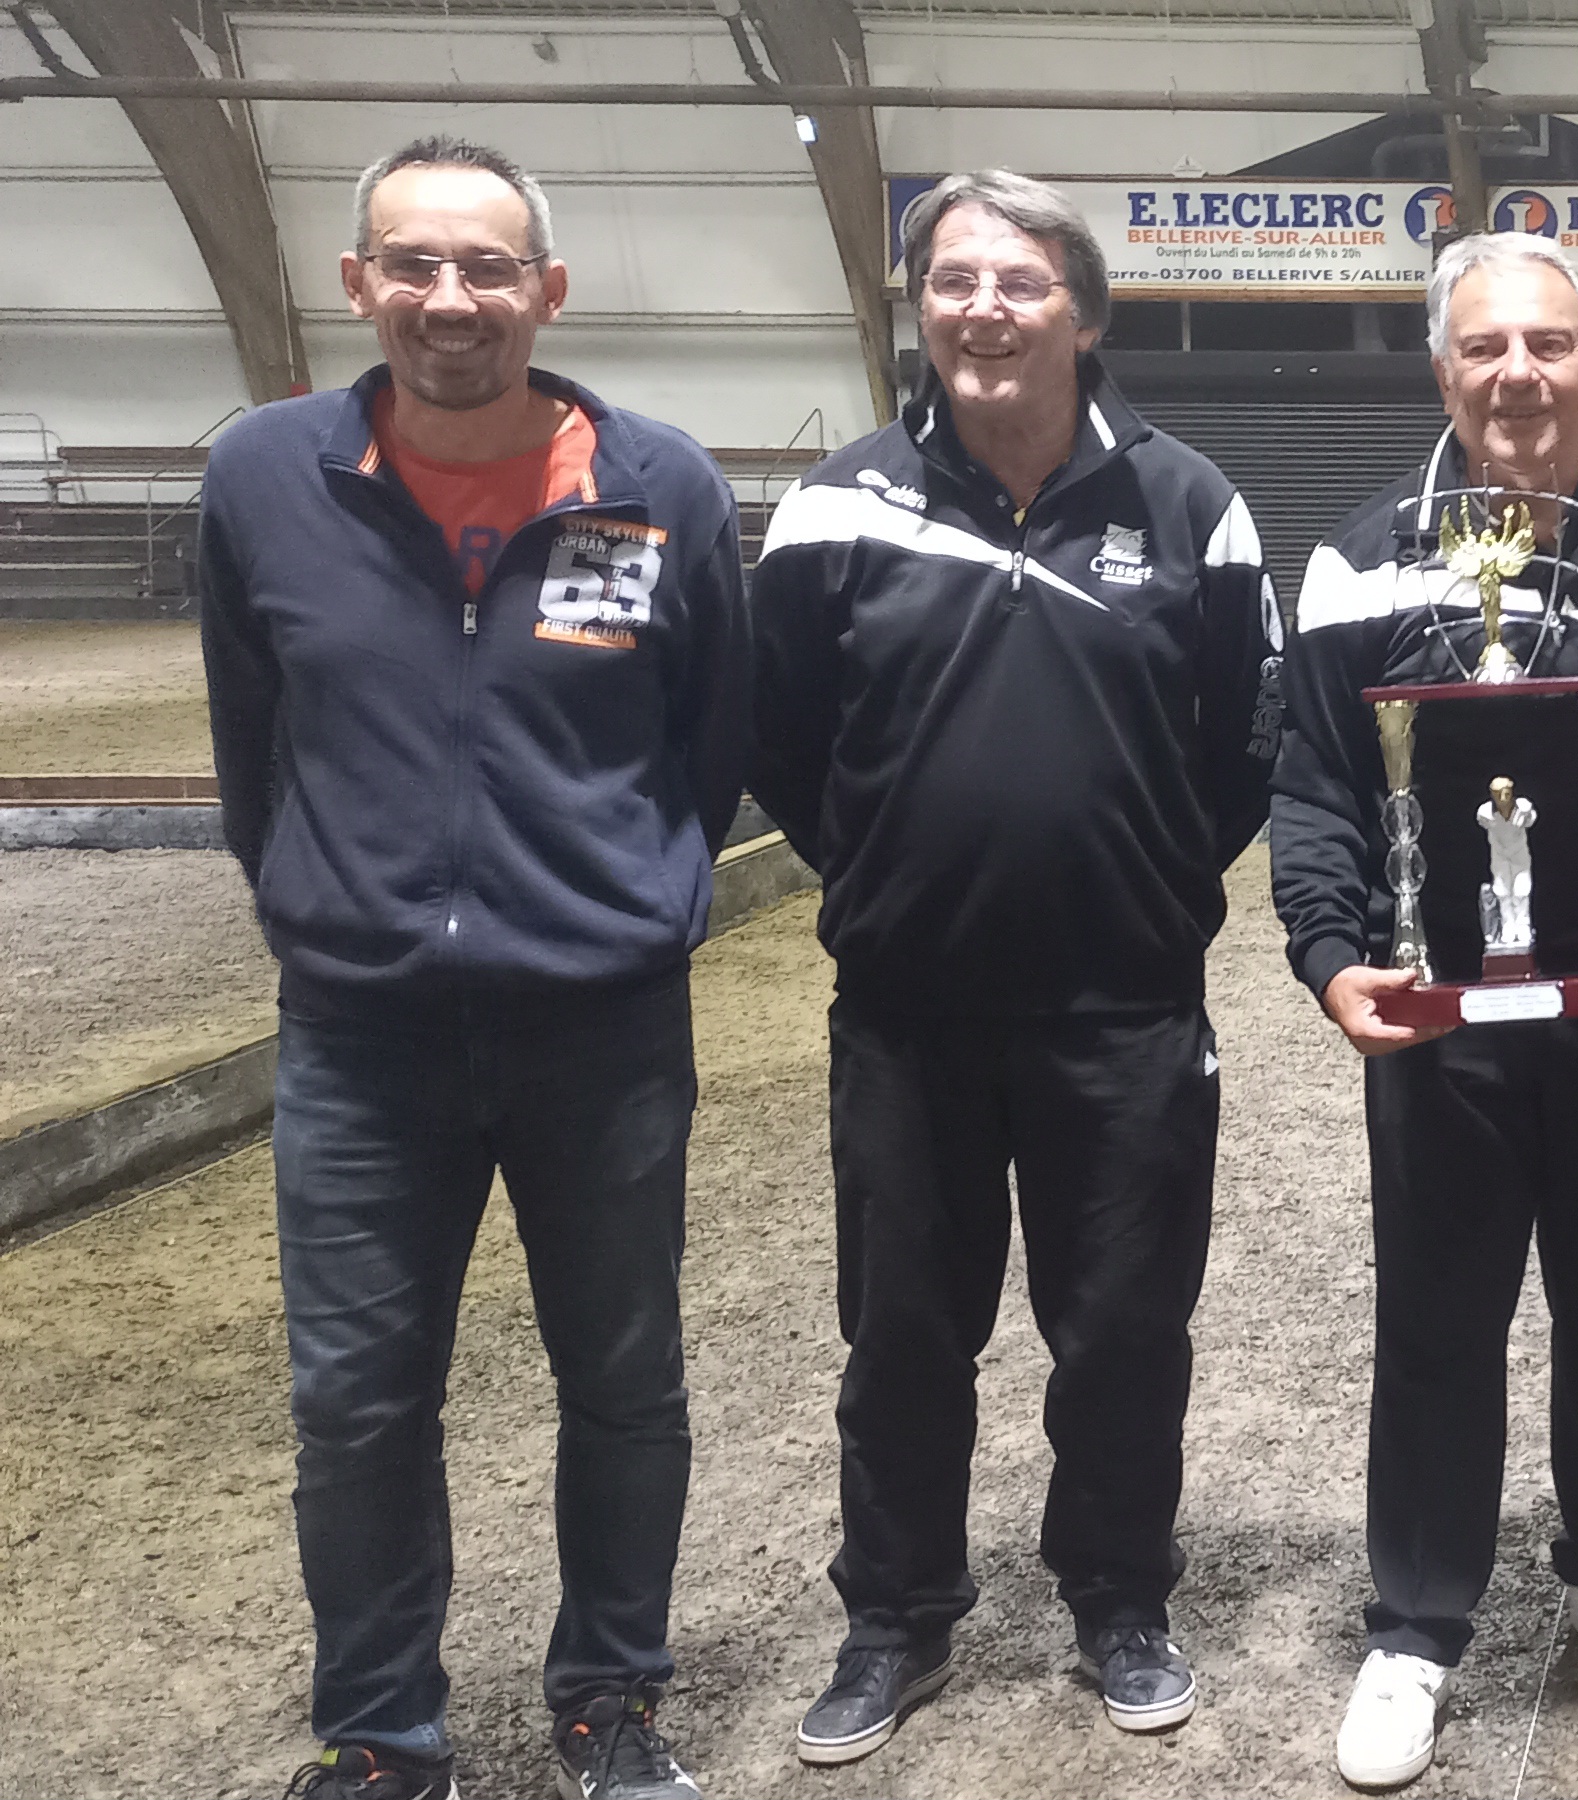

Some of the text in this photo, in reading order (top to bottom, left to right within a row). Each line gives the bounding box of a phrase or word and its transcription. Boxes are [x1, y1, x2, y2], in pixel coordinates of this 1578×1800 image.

[1127, 192, 1385, 229] E.LECLERC
[1127, 230, 1386, 245] BELLERIVE-SUR-ALLIER
[1156, 246, 1192, 258] Ouvert
[1194, 246, 1207, 258] du
[1210, 246, 1239, 258] Lundi
[1241, 249, 1255, 258] au
[1257, 247, 1296, 259] Samedi
[1299, 247, 1312, 259] de
[1106, 267, 1426, 282] arre-03700 BELLERIVE S/ALLIER
[564, 520, 599, 537] CITY
[556, 535, 609, 556] URBAN
[1089, 555, 1154, 581] Cusset
[538, 532, 663, 626] 63
[541, 617, 582, 638] FIRST
